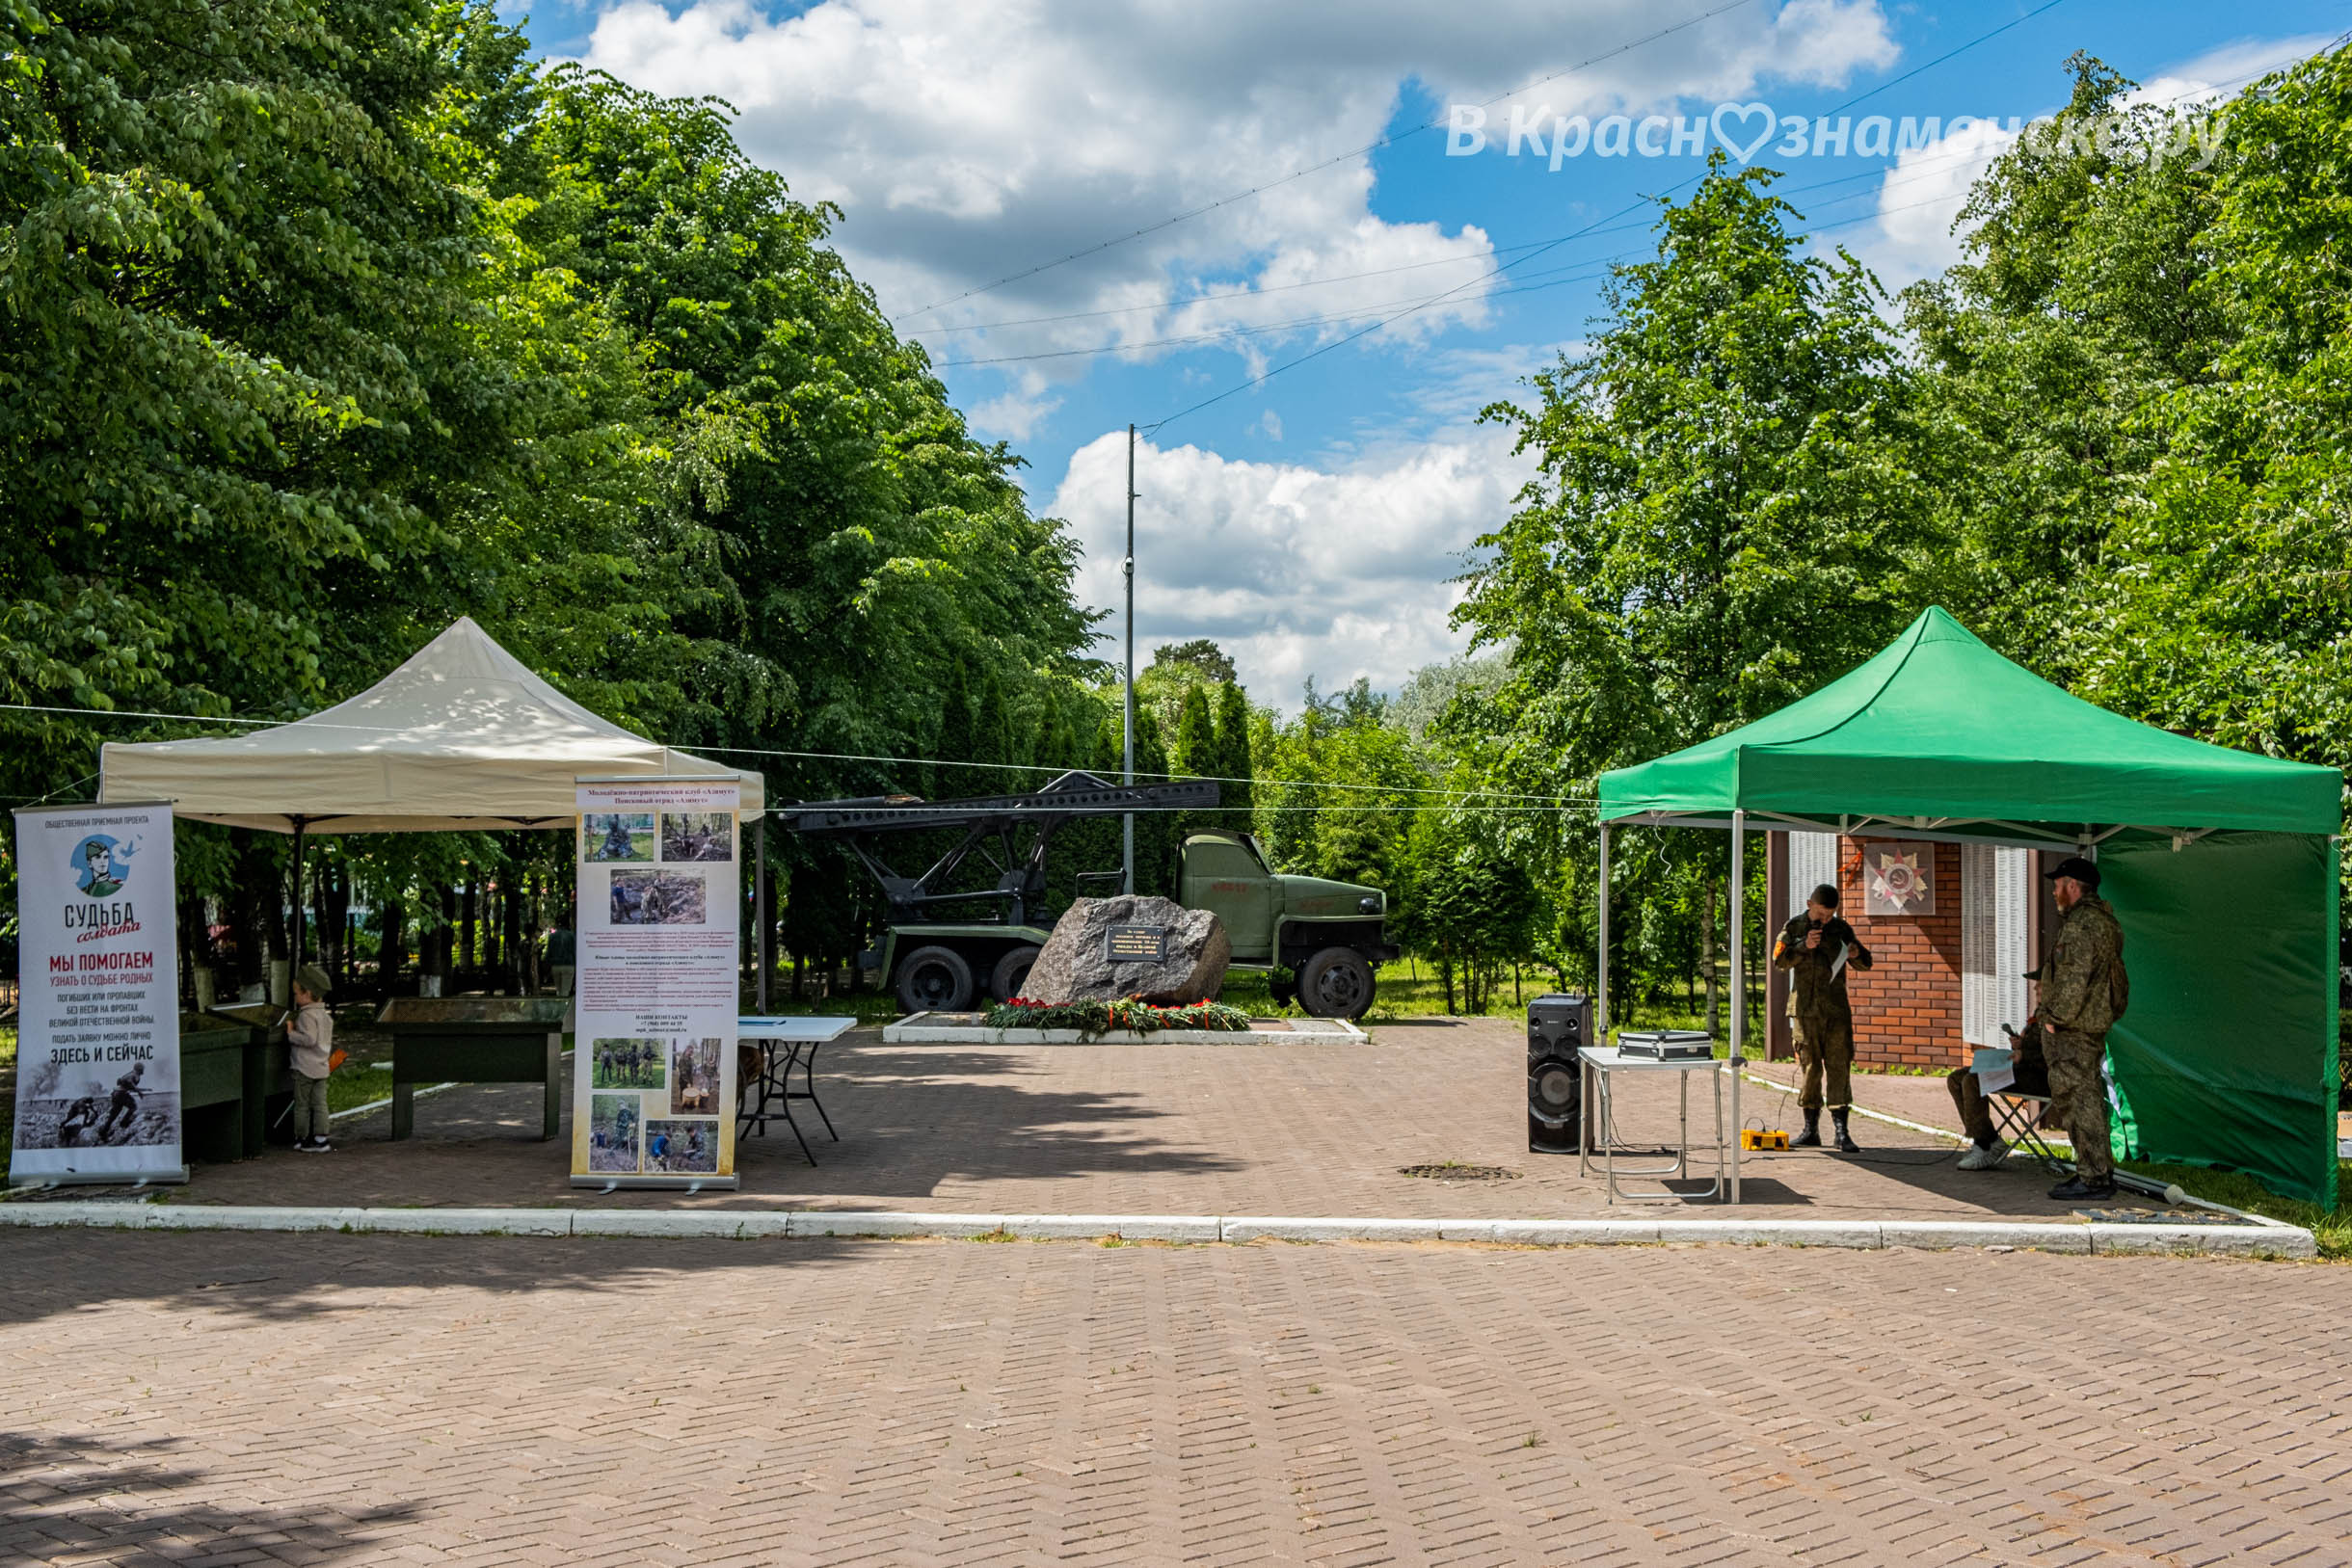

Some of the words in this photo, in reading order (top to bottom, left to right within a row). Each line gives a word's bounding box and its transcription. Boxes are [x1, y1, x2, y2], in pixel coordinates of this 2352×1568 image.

[123, 814, 149, 825] ПРОЕКТА
[65, 902, 134, 930] СУДЬБА
[77, 918, 141, 943] солдата
[49, 954, 74, 972] МЫ
[79, 951, 153, 970] ПОМОГАЕМ
[50, 974, 79, 987] УЗНАТЬ
[81, 974, 87, 986] О
[89, 973, 117, 986] СУДЬБЕ
[120, 972, 153, 985] РОДНЫХ
[57, 993, 91, 1003] ПОГИБШИХ
[93, 992, 105, 1001] ИЛИ
[107, 991, 146, 1001] ПРОПАВШИХ
[67, 1005, 78, 1015] БЕЗ
[79, 1004, 98, 1015] ВЕСТИ
[100, 1004, 109, 1013] НА
[111, 1003, 139, 1013] ФРОНТАХ
[48, 1017, 78, 1028] ВЕЛИКОЙ
[79, 1015, 130, 1027] ОТЕЧЕСТВЕННОЙ
[131, 1014, 155, 1025] ВОЙНЫ
[52, 1033, 76, 1044] ПОДАТЬ
[78, 1033, 101, 1044] ЗАЯВКУ
[103, 1032, 129, 1042] МОЖНО
[130, 1031, 151, 1042] ЛИЧНО
[50, 1048, 90, 1066] ЗДЕСЬ
[94, 1047, 102, 1063] И
[107, 1043, 153, 1062] СЕЙЧАС
